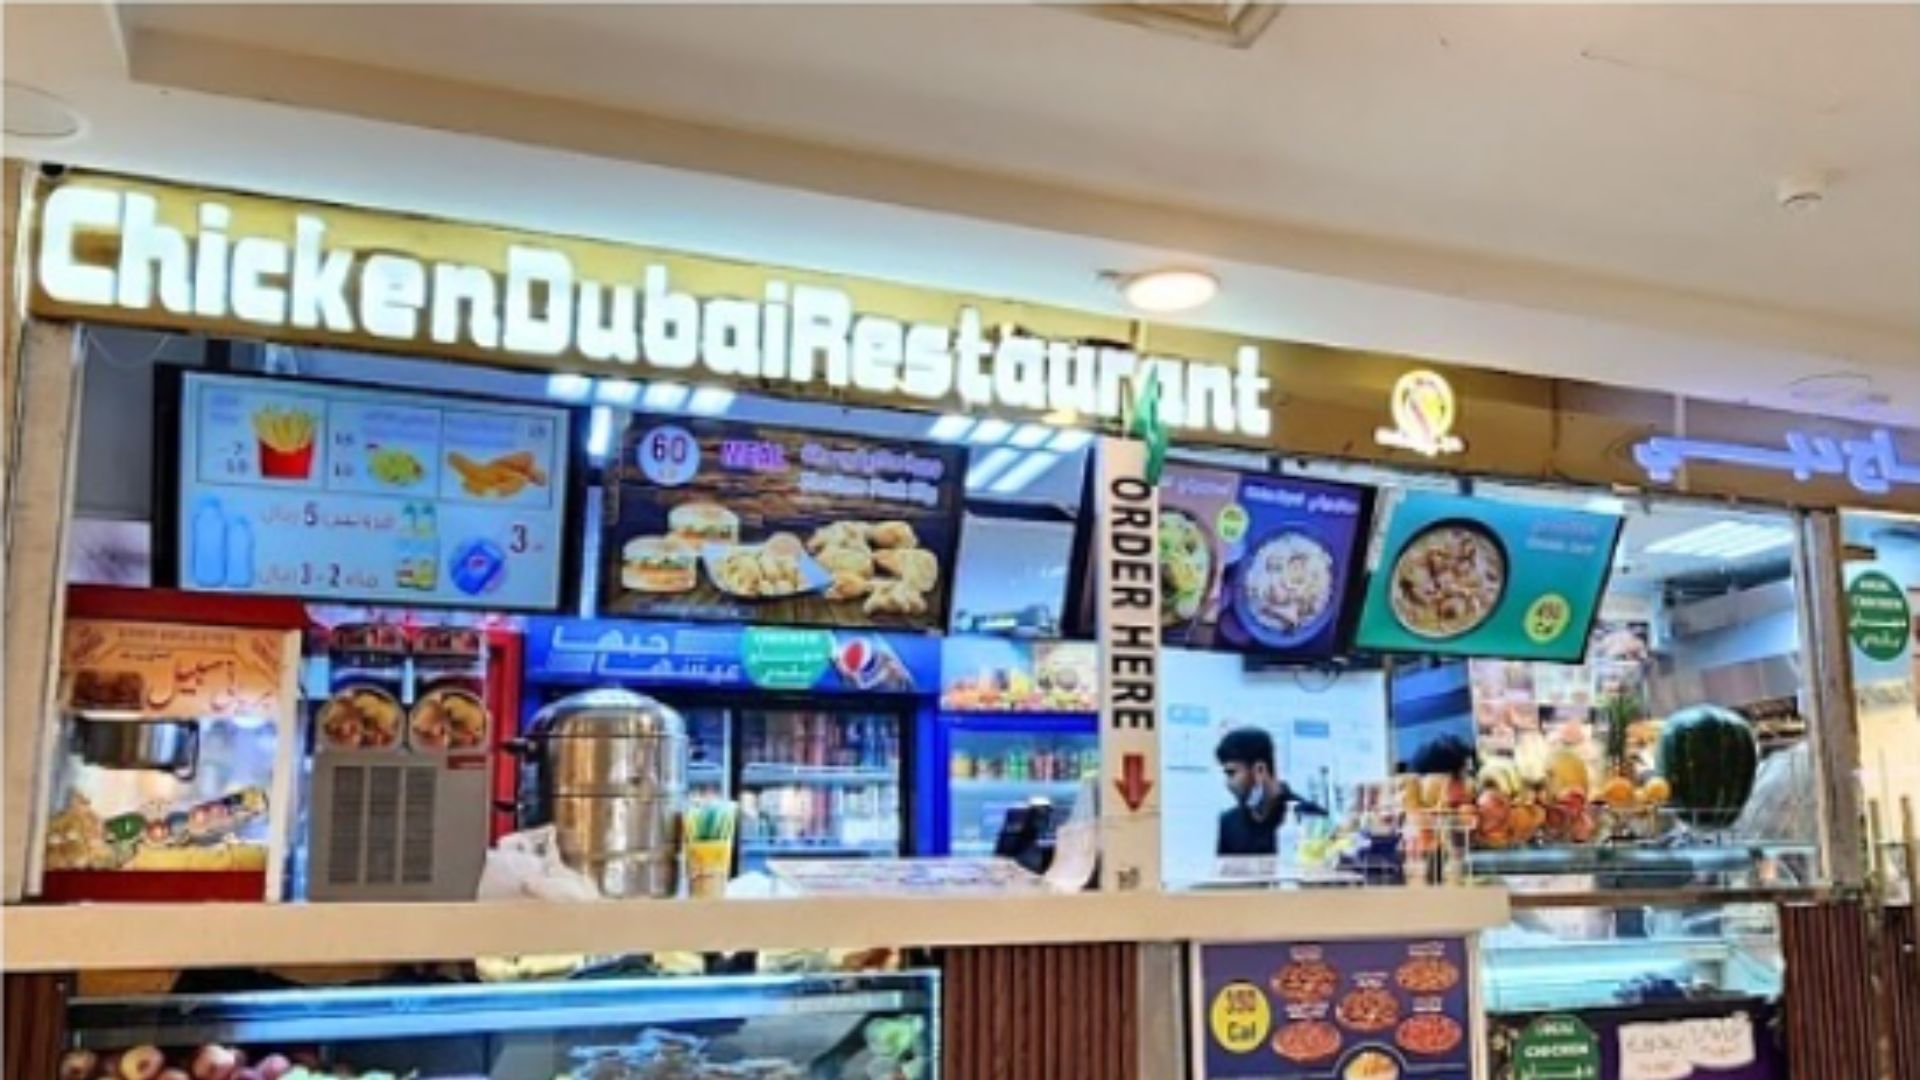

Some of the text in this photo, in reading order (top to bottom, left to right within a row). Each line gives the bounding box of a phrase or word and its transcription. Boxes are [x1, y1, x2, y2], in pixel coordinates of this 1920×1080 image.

[653, 433, 687, 464] 60
[511, 525, 528, 552] 3
[1111, 477, 1155, 731] ORDER HERE
[1226, 1021, 1257, 1043] Cal
